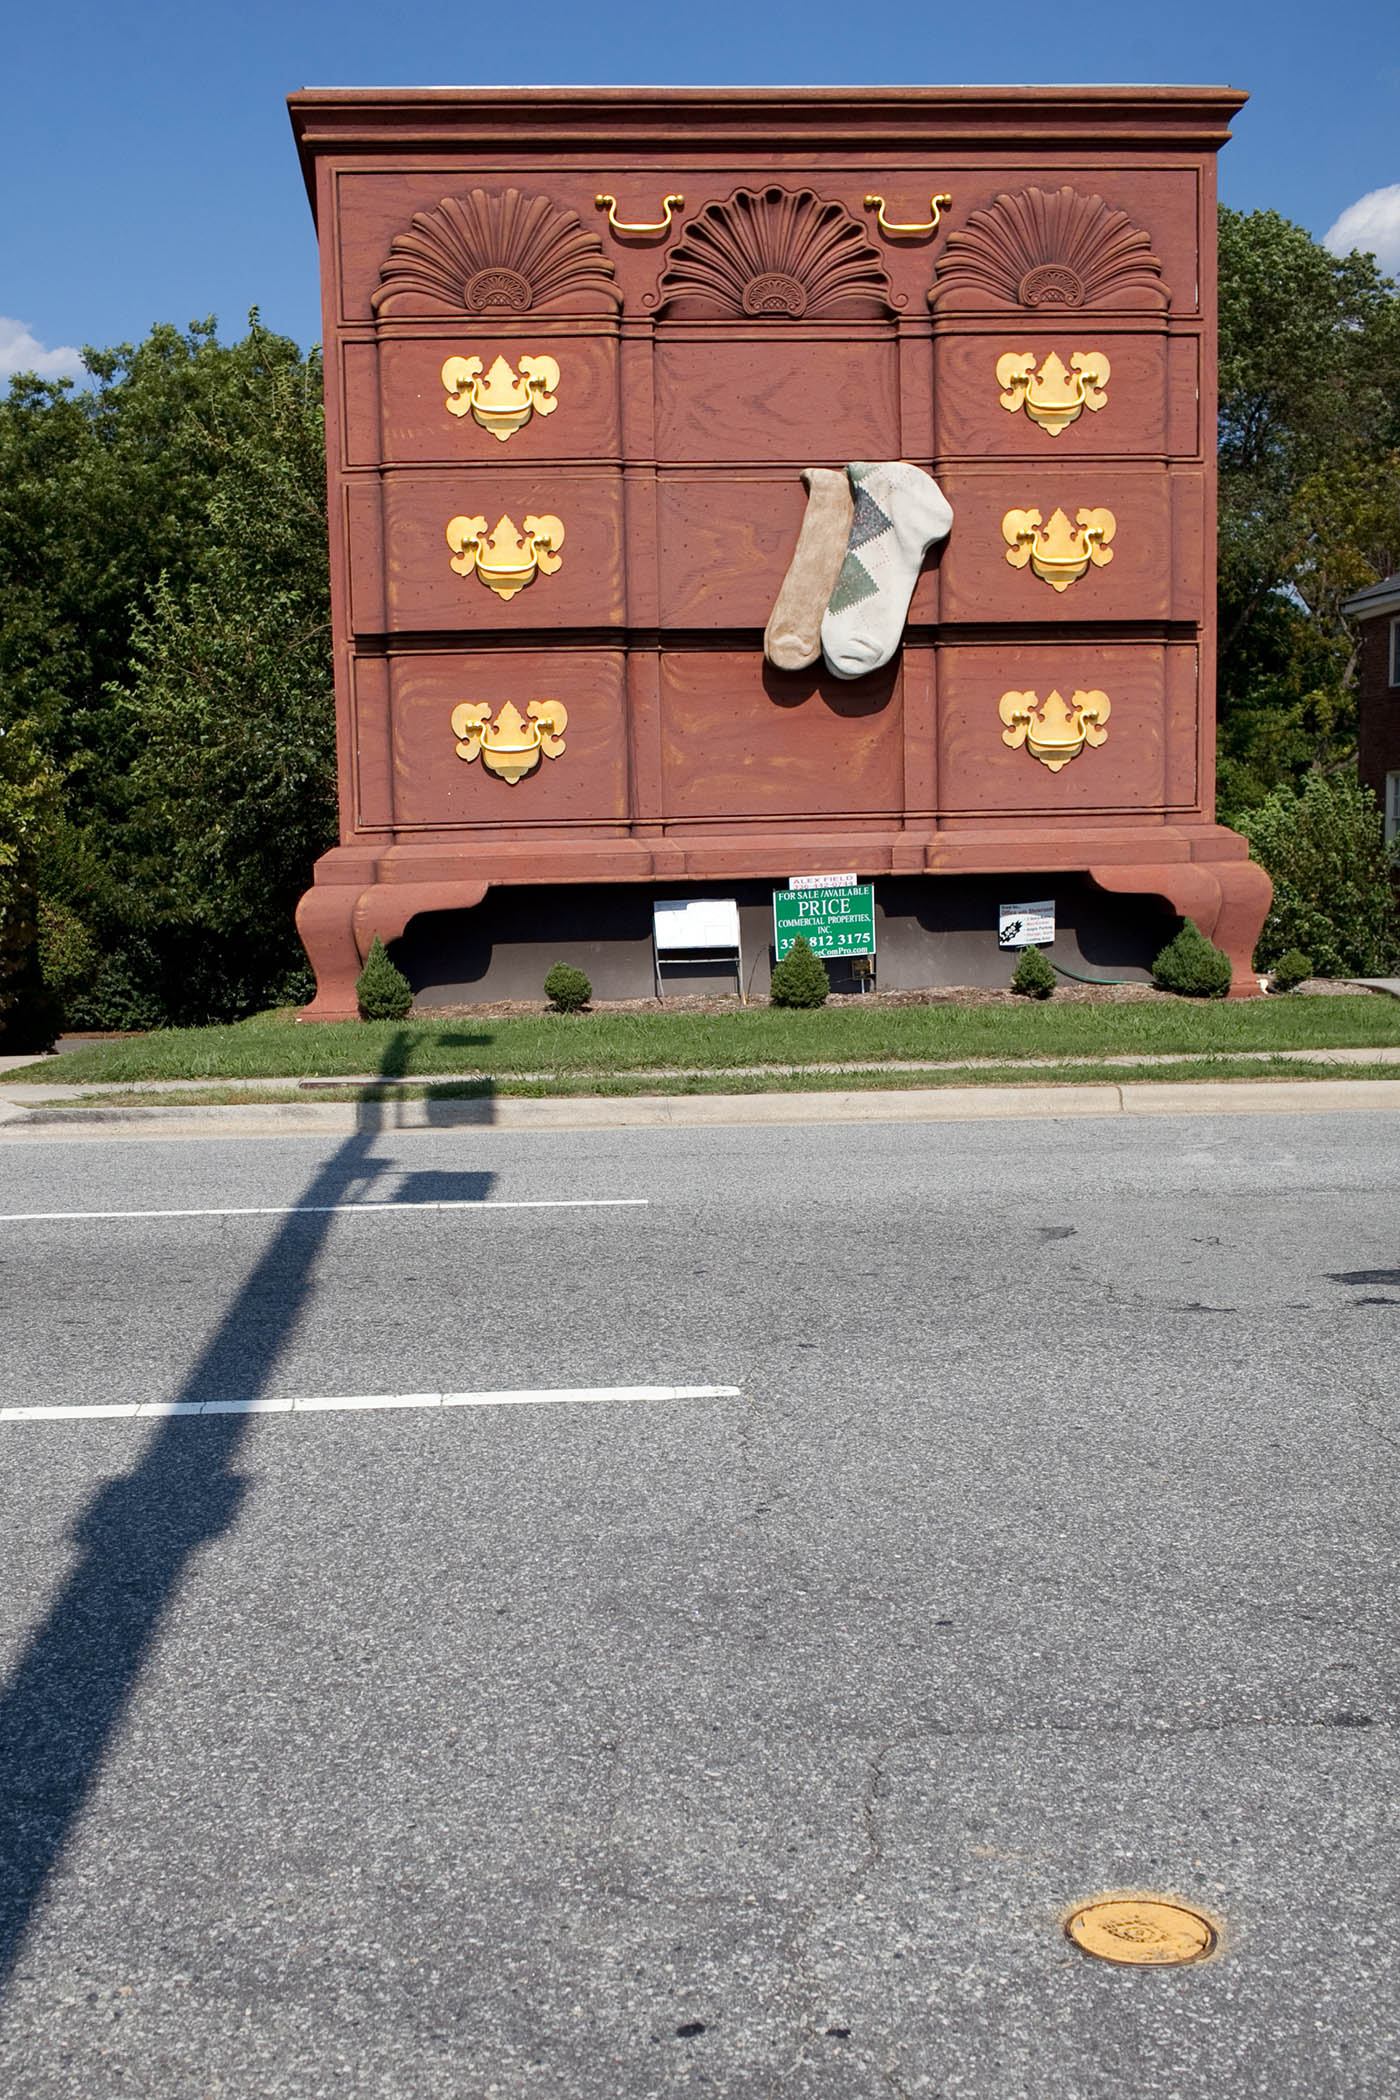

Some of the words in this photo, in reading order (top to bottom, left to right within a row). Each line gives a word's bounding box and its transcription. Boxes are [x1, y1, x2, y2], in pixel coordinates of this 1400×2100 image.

[778, 892, 796, 901] FOR
[798, 898, 851, 917] PRICE
[778, 917, 825, 928] COMMERCIAL
[817, 926, 833, 934] INC.
[780, 938, 796, 950] 33
[809, 935, 834, 947] 812
[837, 932, 871, 945] 3175
